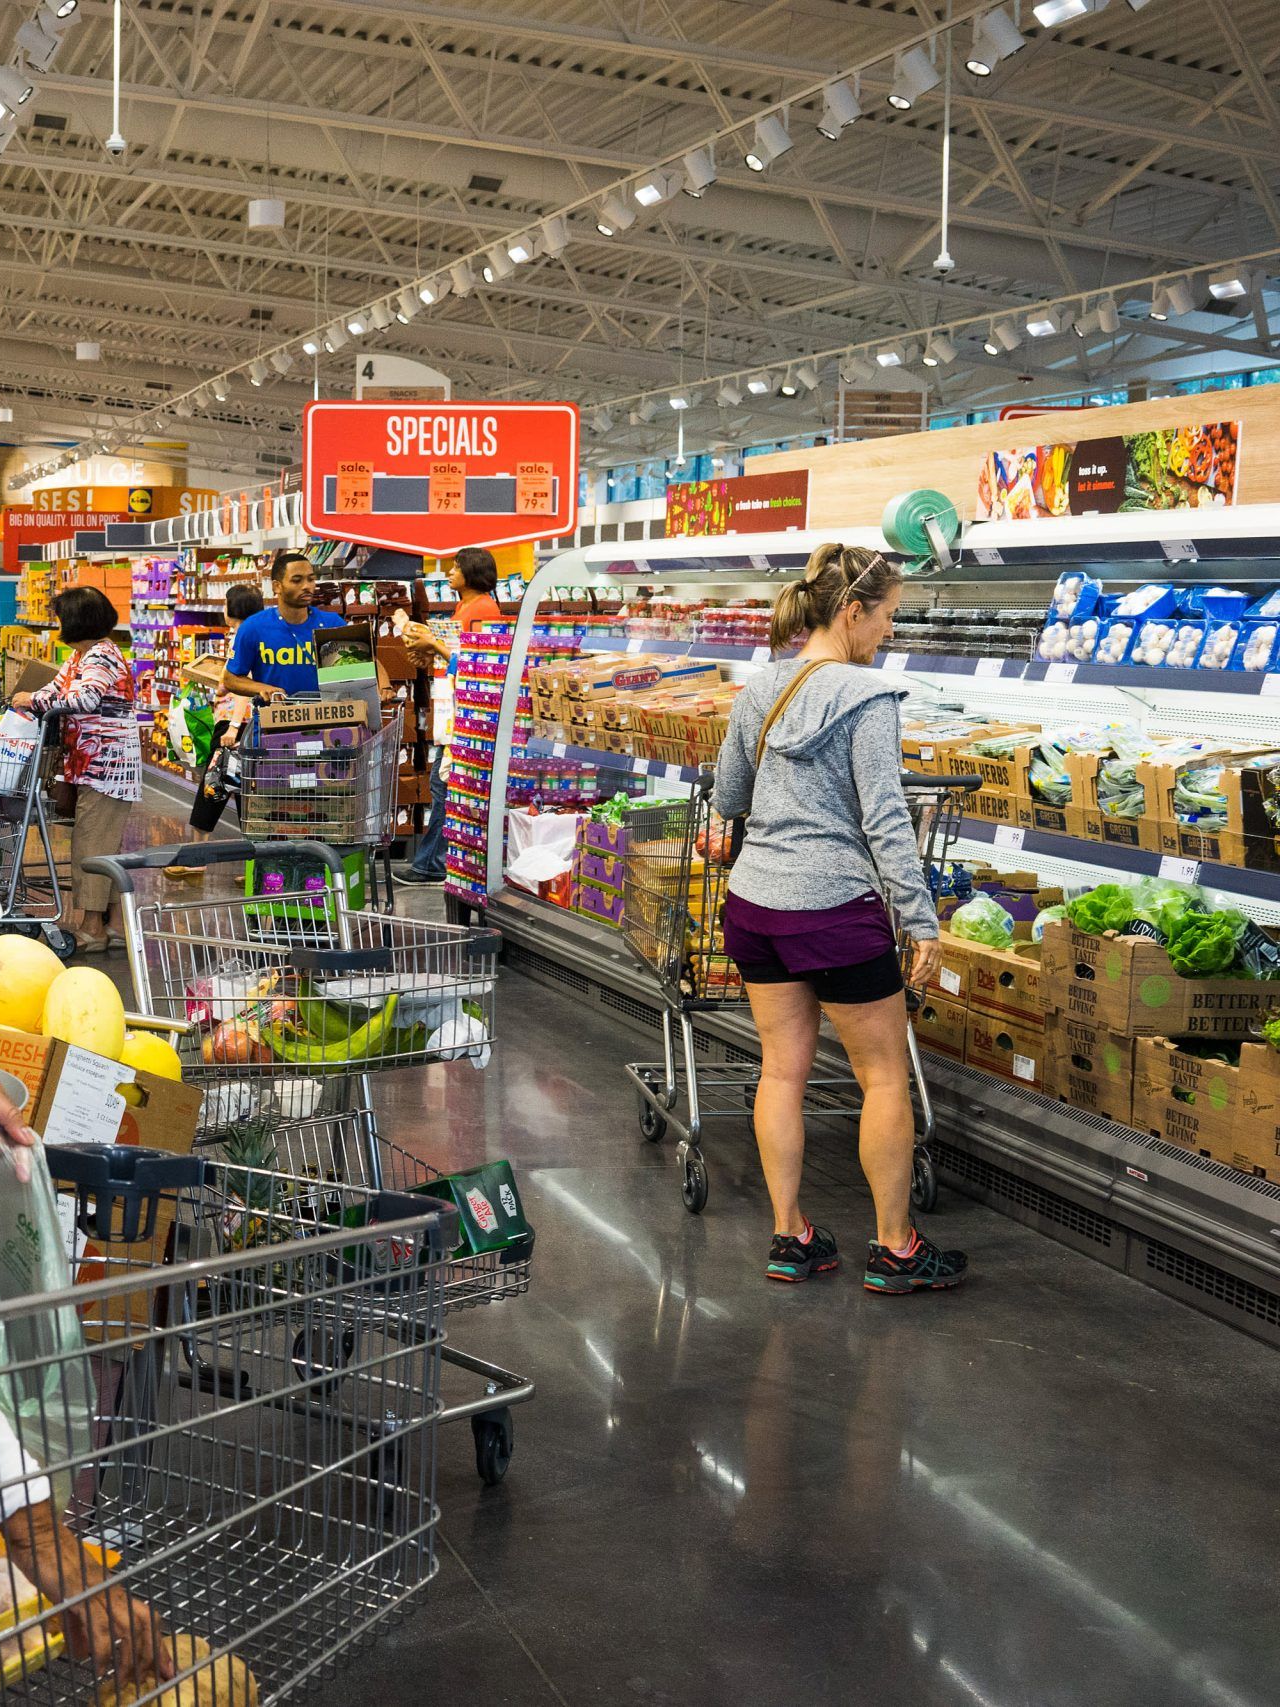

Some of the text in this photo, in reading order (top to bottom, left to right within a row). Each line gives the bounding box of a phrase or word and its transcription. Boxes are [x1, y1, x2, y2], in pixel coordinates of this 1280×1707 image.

[361, 361, 375, 380] 4
[387, 415, 498, 457] SPECIALS
[340, 462, 370, 472] sale.
[433, 464, 462, 474] sale.
[520, 464, 549, 474] sale.
[344, 497, 358, 508] 79
[437, 498, 451, 509] 79
[524, 498, 538, 509] 79
[10, 514, 22, 527] BIG
[24, 514, 34, 527] ON
[70, 515, 83, 527] LIDL
[85, 515, 98, 527] ON
[614, 671, 658, 688] GIANT
[272, 705, 355, 723] FRESH HERBS
[1, 747, 16, 758] the
[978, 763, 1010, 786] HERBS
[980, 795, 1009, 820] HERBS
[1039, 810, 1061, 823] GREEN
[1087, 820, 1132, 837] Dole GREEN
[1163, 835, 1176, 849] Dole
[1181, 866, 1195, 877] 1.99
[1071, 933, 1101, 952] BETTER
[1074, 948, 1097, 965] TASTE
[977, 968, 995, 988] Dole
[1069, 984, 1098, 1003] BETTER
[1192, 993, 1260, 1009] BETTER
[1069, 997, 1095, 1017] LIVING
[1067, 1023, 1096, 1044] BETTER
[1188, 1016, 1254, 1032] BETTER
[974, 1028, 992, 1050] Dole
[1070, 1037, 1093, 1056] TASTE
[1170, 1053, 1202, 1076] BETTER
[1069, 1074, 1098, 1095] BETTER
[1173, 1069, 1199, 1089] TASTE
[1070, 1088, 1097, 1108] LIVING
[1166, 1107, 1199, 1132] BETTER
[1166, 1123, 1197, 1145] LIVING
[481, 1202, 493, 1216] Ale
[504, 1190, 516, 1211] PACK
[469, 1195, 488, 1230] Ginger
